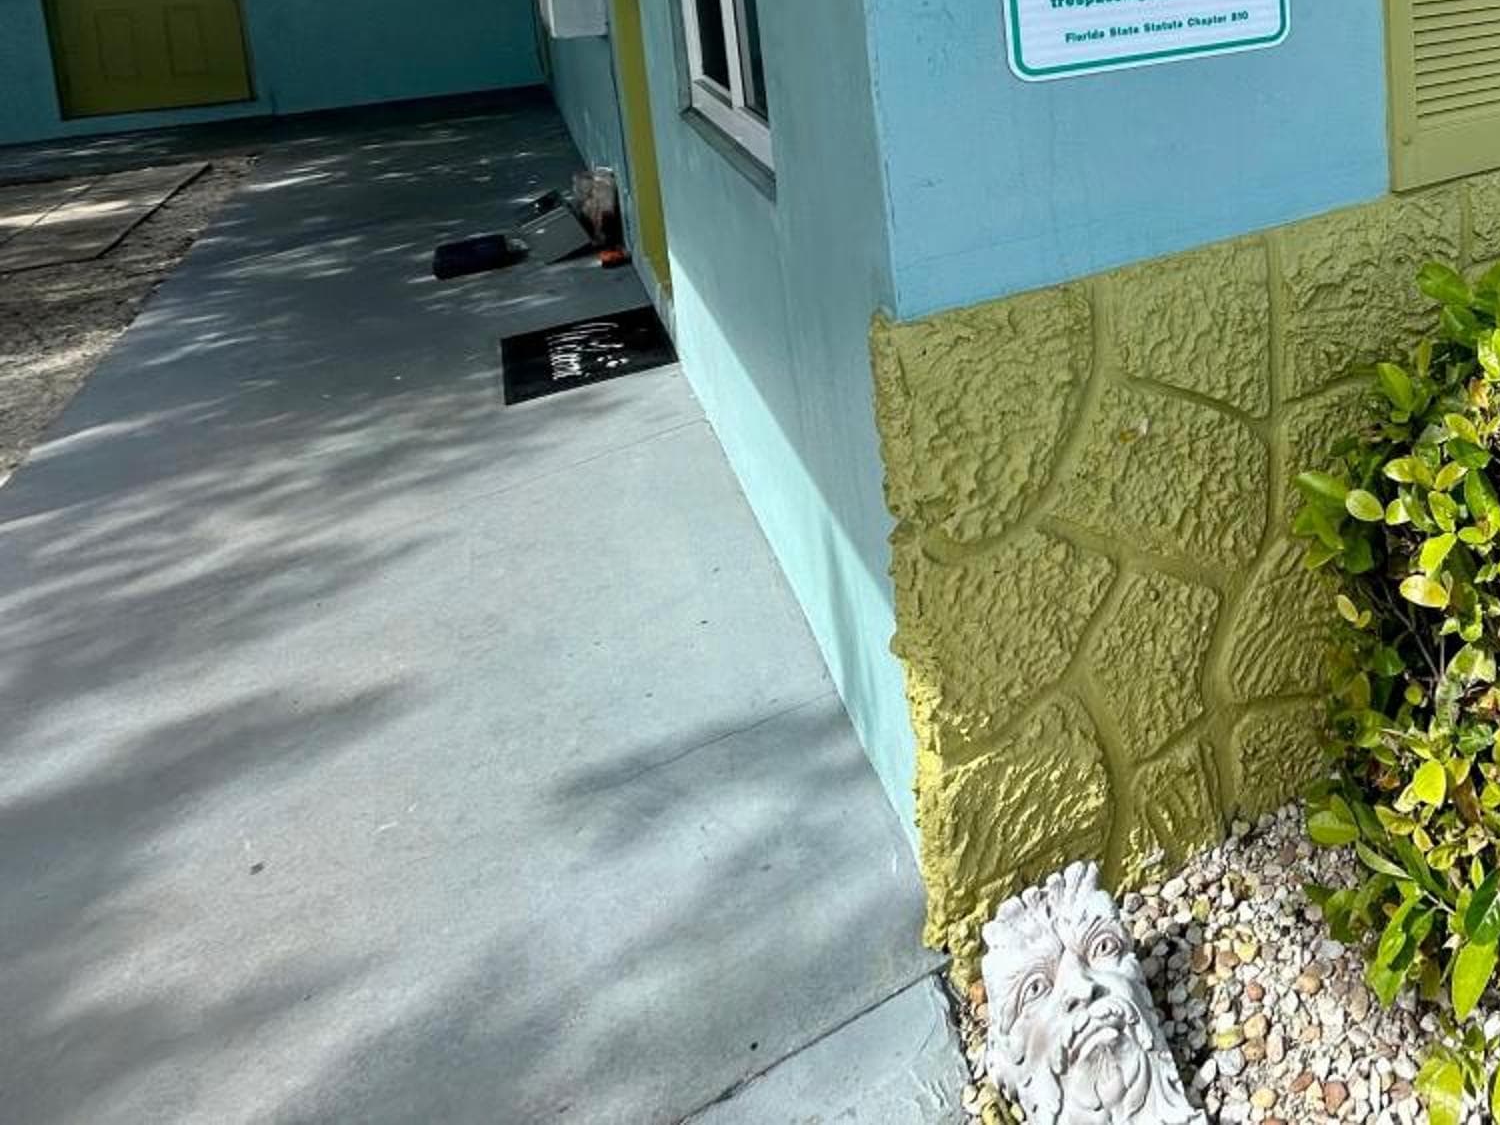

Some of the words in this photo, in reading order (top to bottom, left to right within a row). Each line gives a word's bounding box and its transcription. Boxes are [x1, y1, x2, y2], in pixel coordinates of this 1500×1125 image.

[1065, 30, 1105, 43] Florida
[1109, 26, 1139, 37] State
[1187, 16, 1227, 27] Chapter
